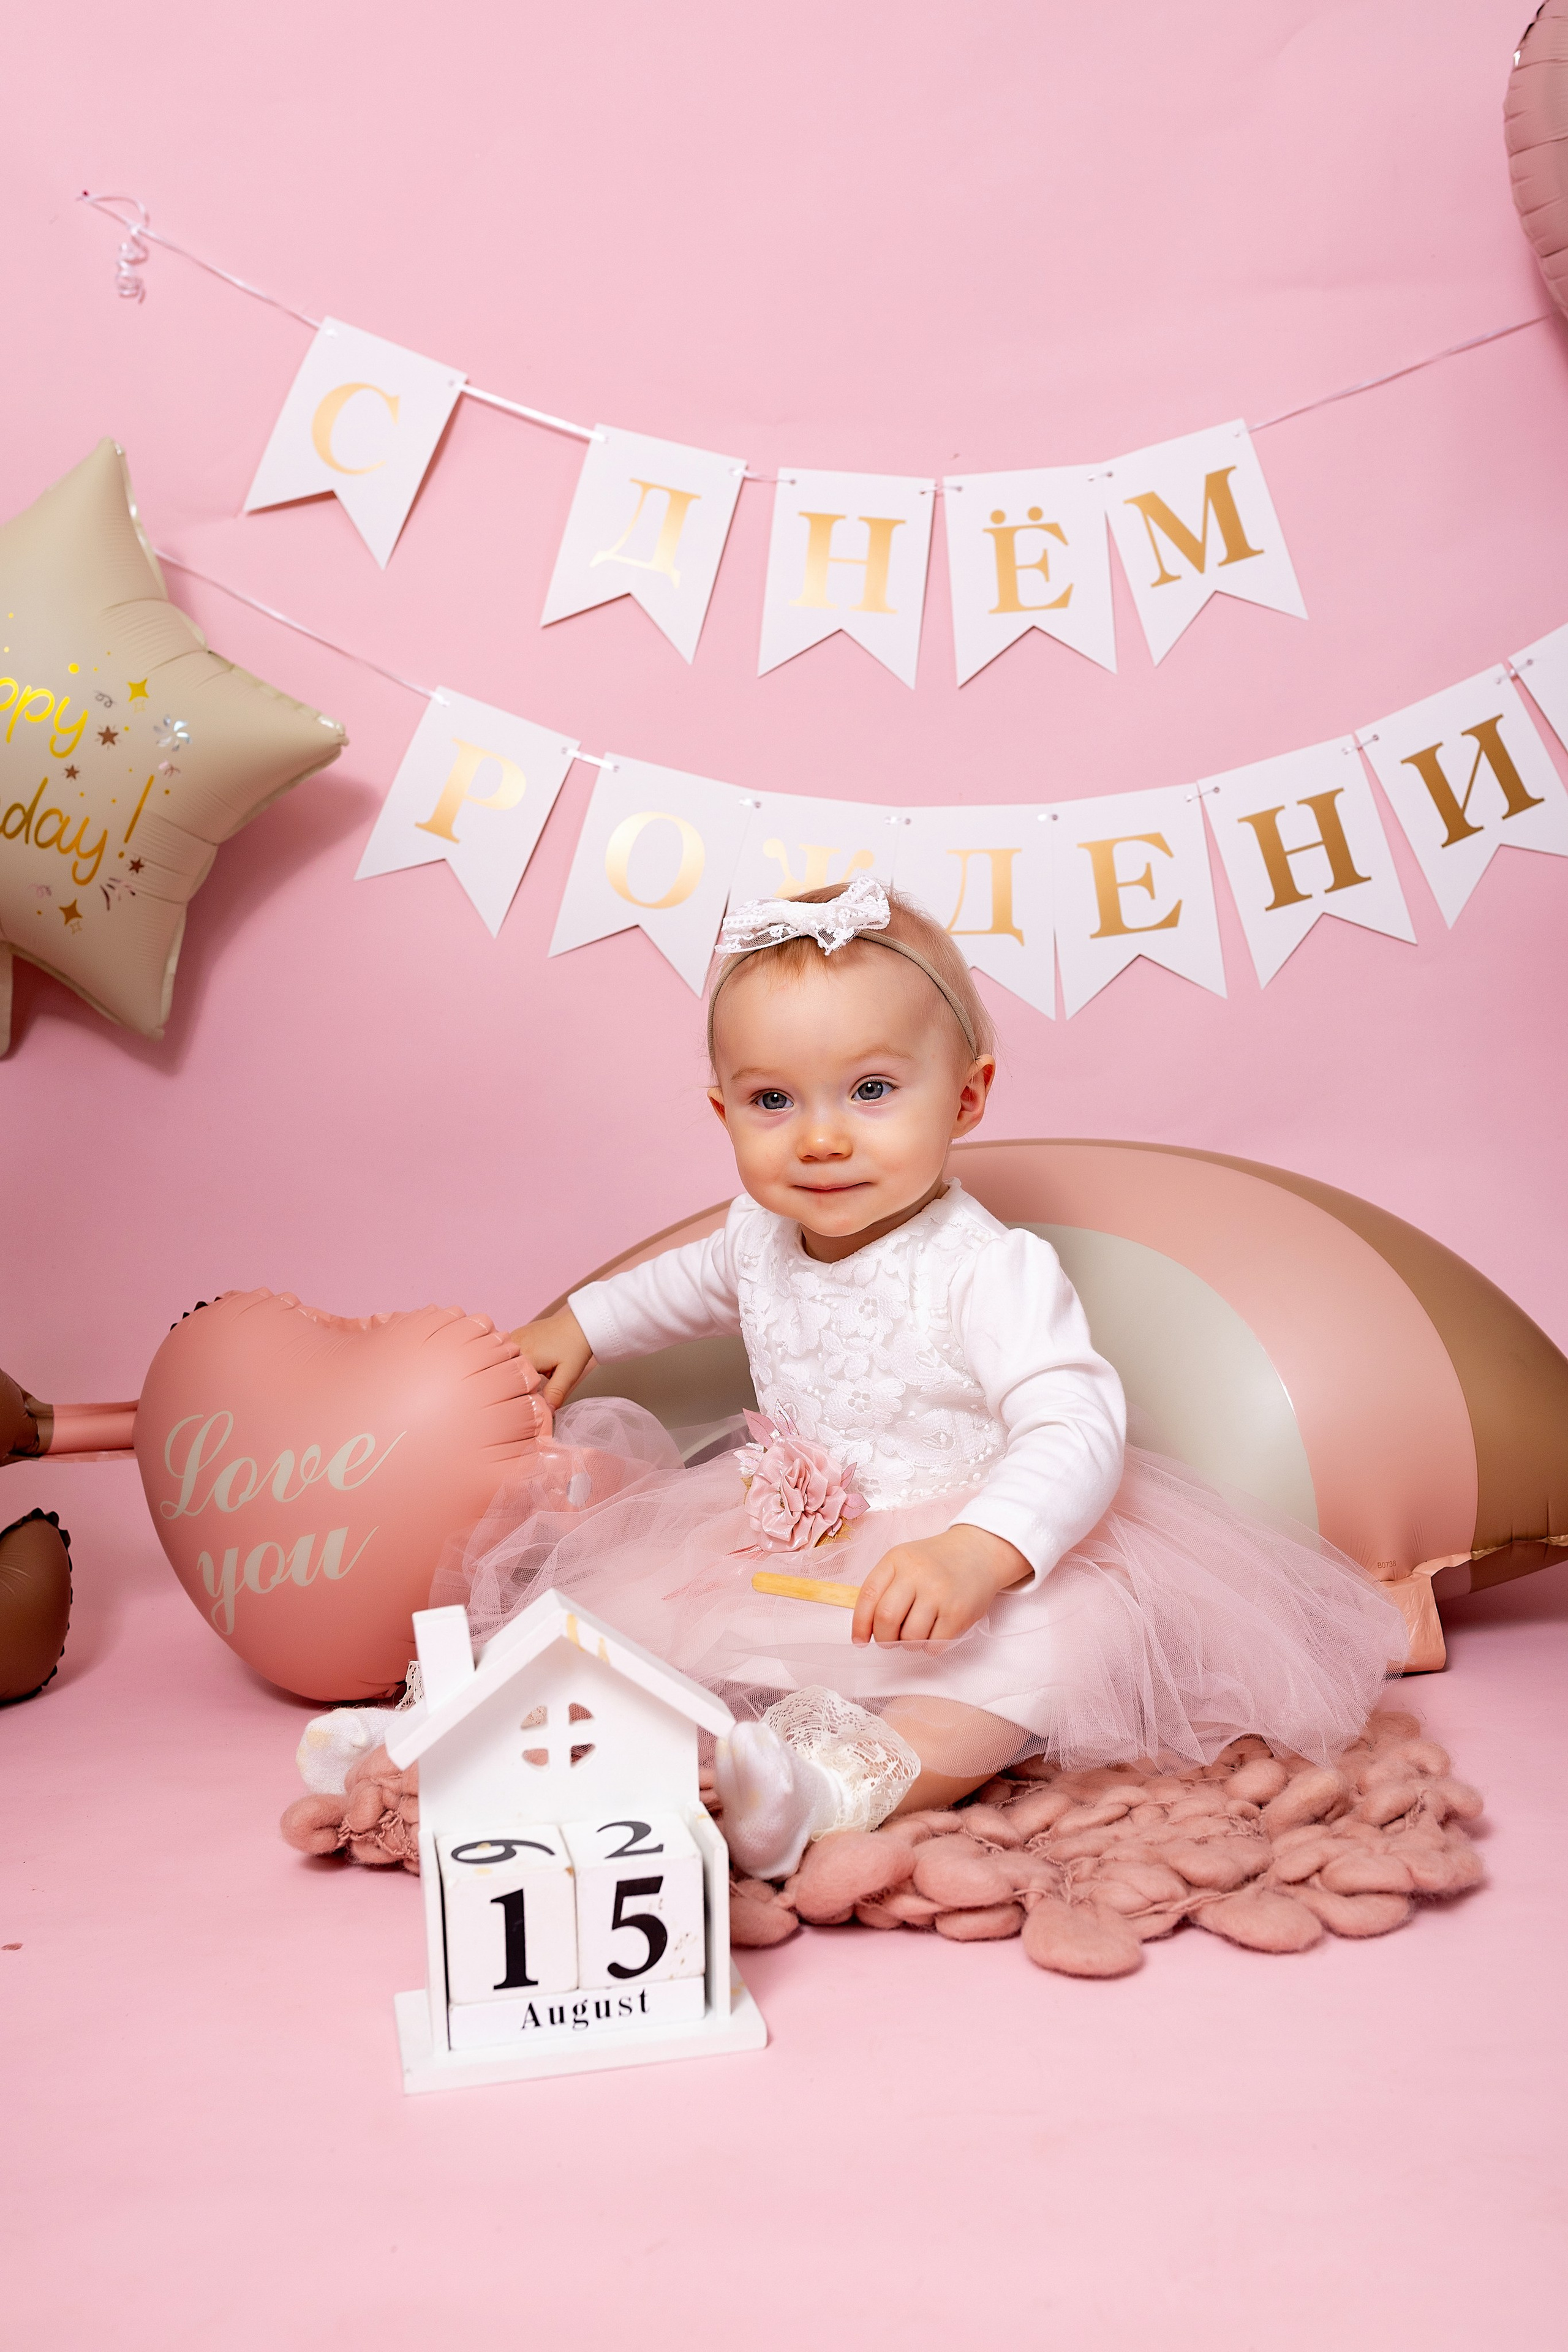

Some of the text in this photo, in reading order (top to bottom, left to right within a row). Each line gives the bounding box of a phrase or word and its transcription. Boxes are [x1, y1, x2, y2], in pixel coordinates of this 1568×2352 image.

[312, 382, 1265, 615] С ДНЁМ
[160, 1410, 407, 1520] Love
[197, 1525, 380, 1636] you
[1377, 1560, 1396, 1569] B0738
[521, 1988, 651, 2032] August
